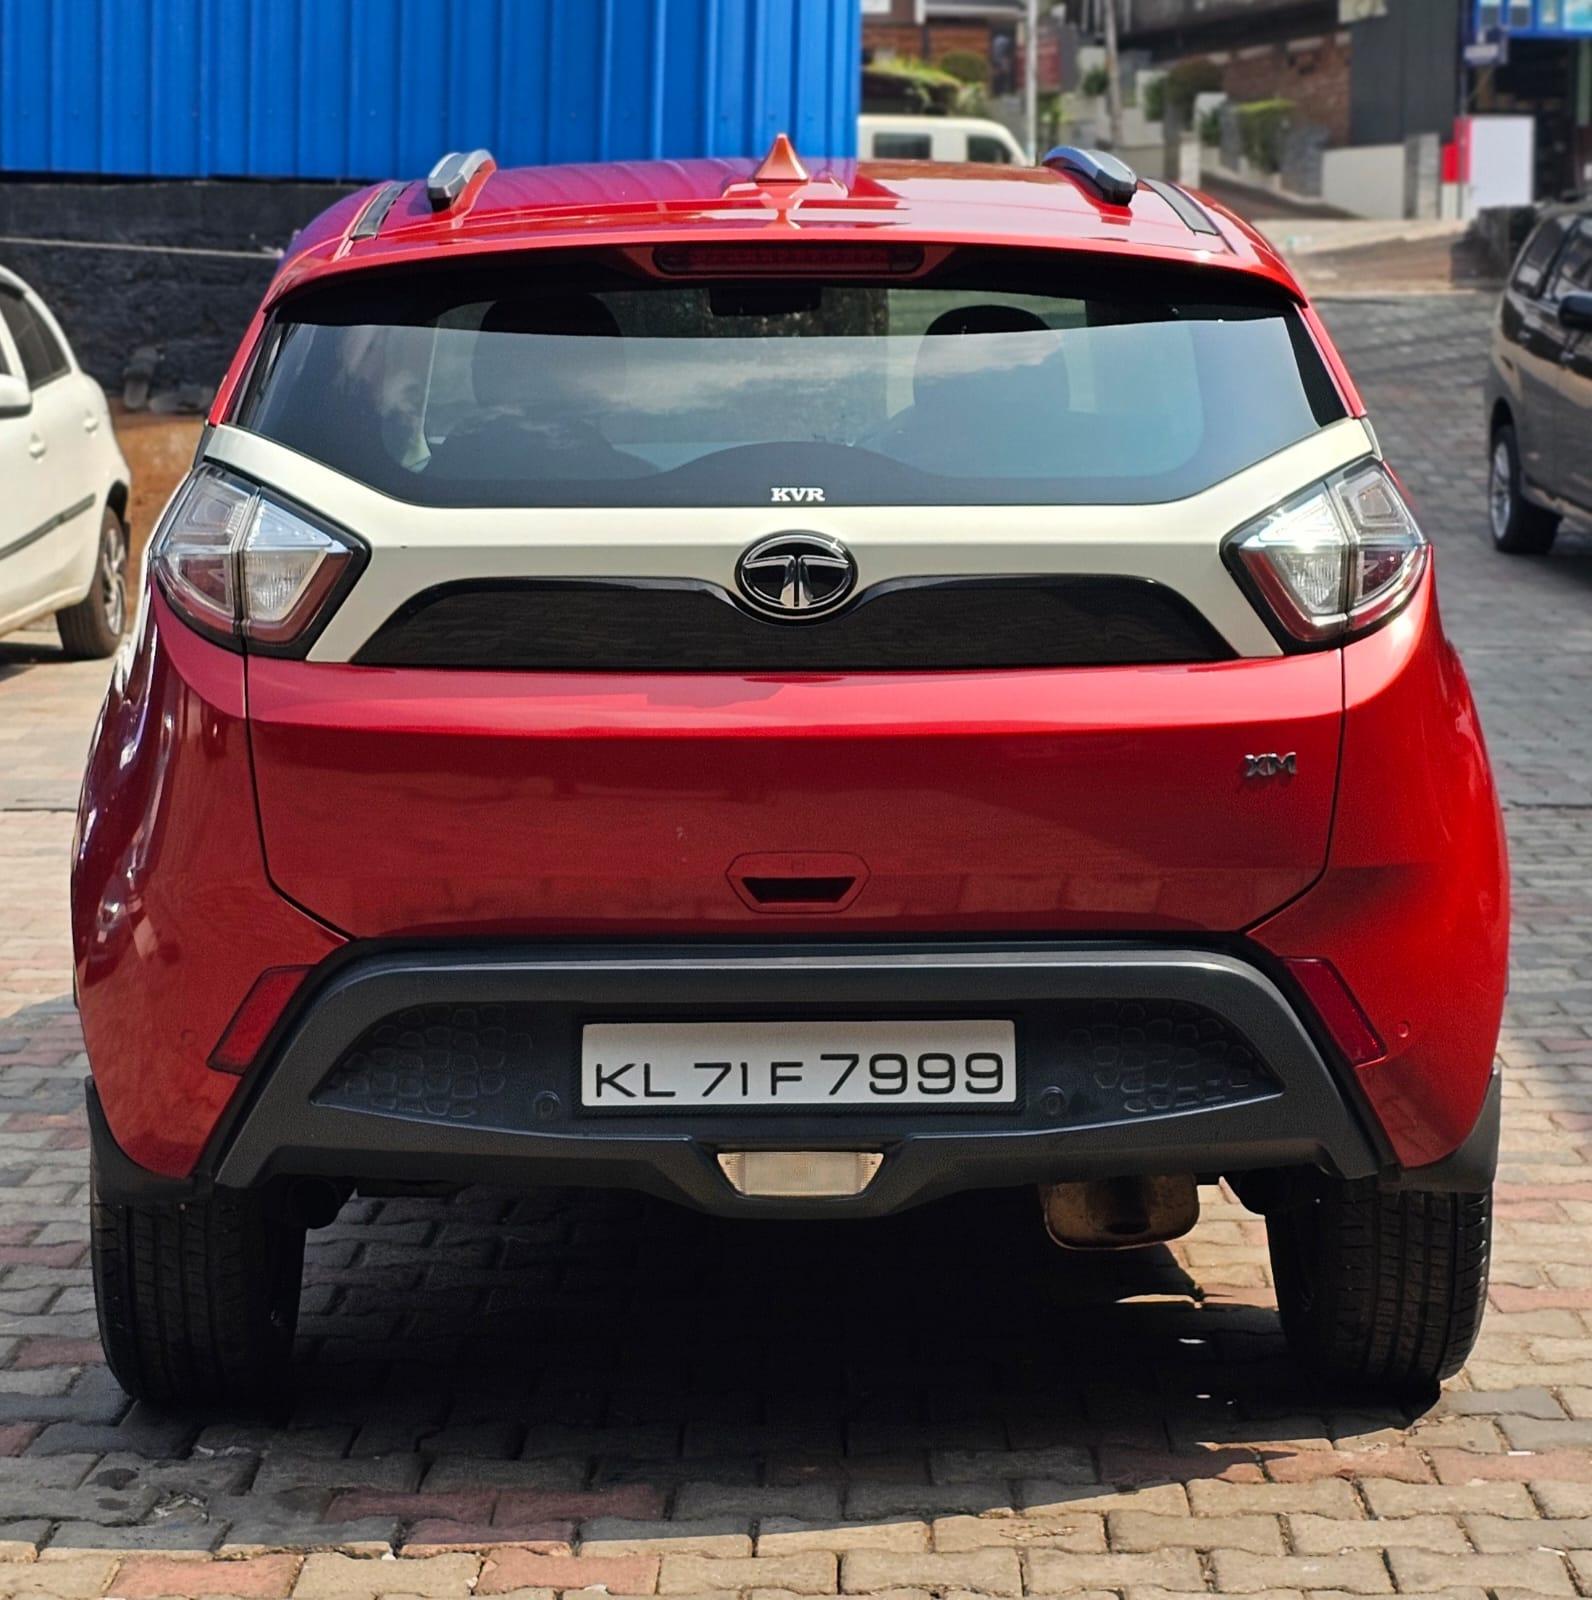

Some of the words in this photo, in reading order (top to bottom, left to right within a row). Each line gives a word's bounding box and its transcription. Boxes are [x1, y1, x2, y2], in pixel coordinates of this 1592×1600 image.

[771, 487, 825, 502] KVR
[1244, 752, 1297, 777] XM
[595, 1062, 676, 1098] KL
[693, 1061, 748, 1098] 71
[770, 1061, 804, 1097] F
[819, 1052, 1004, 1096] 7999
